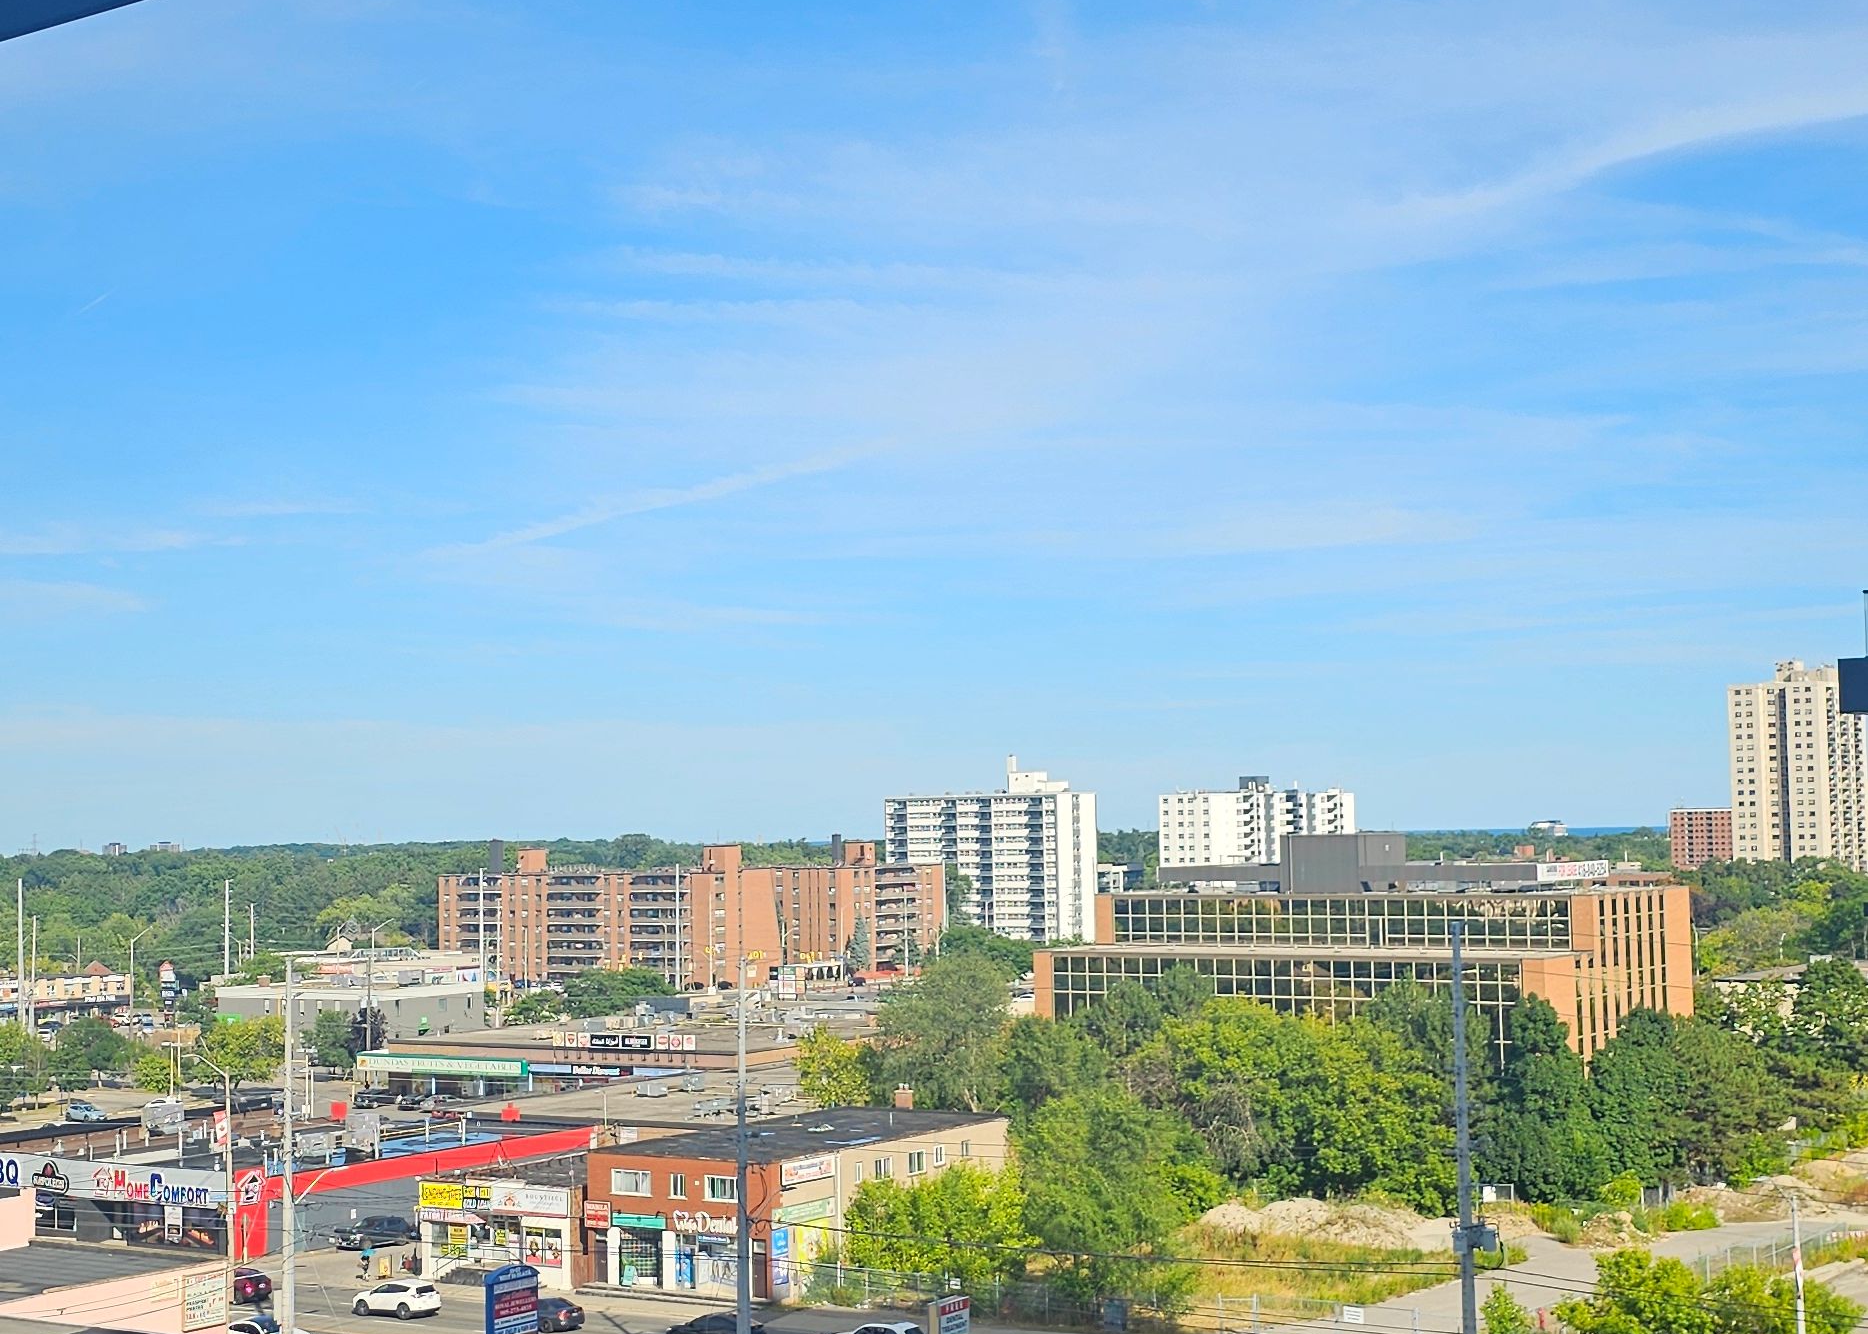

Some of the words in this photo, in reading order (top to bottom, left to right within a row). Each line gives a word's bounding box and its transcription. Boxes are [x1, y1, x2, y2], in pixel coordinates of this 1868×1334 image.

[369, 1058, 408, 1066] DUNDAS
[412, 1059, 444, 1068] FRUITS
[457, 1061, 520, 1071] VEGETABLES
[946, 1301, 963, 1312] FREE
